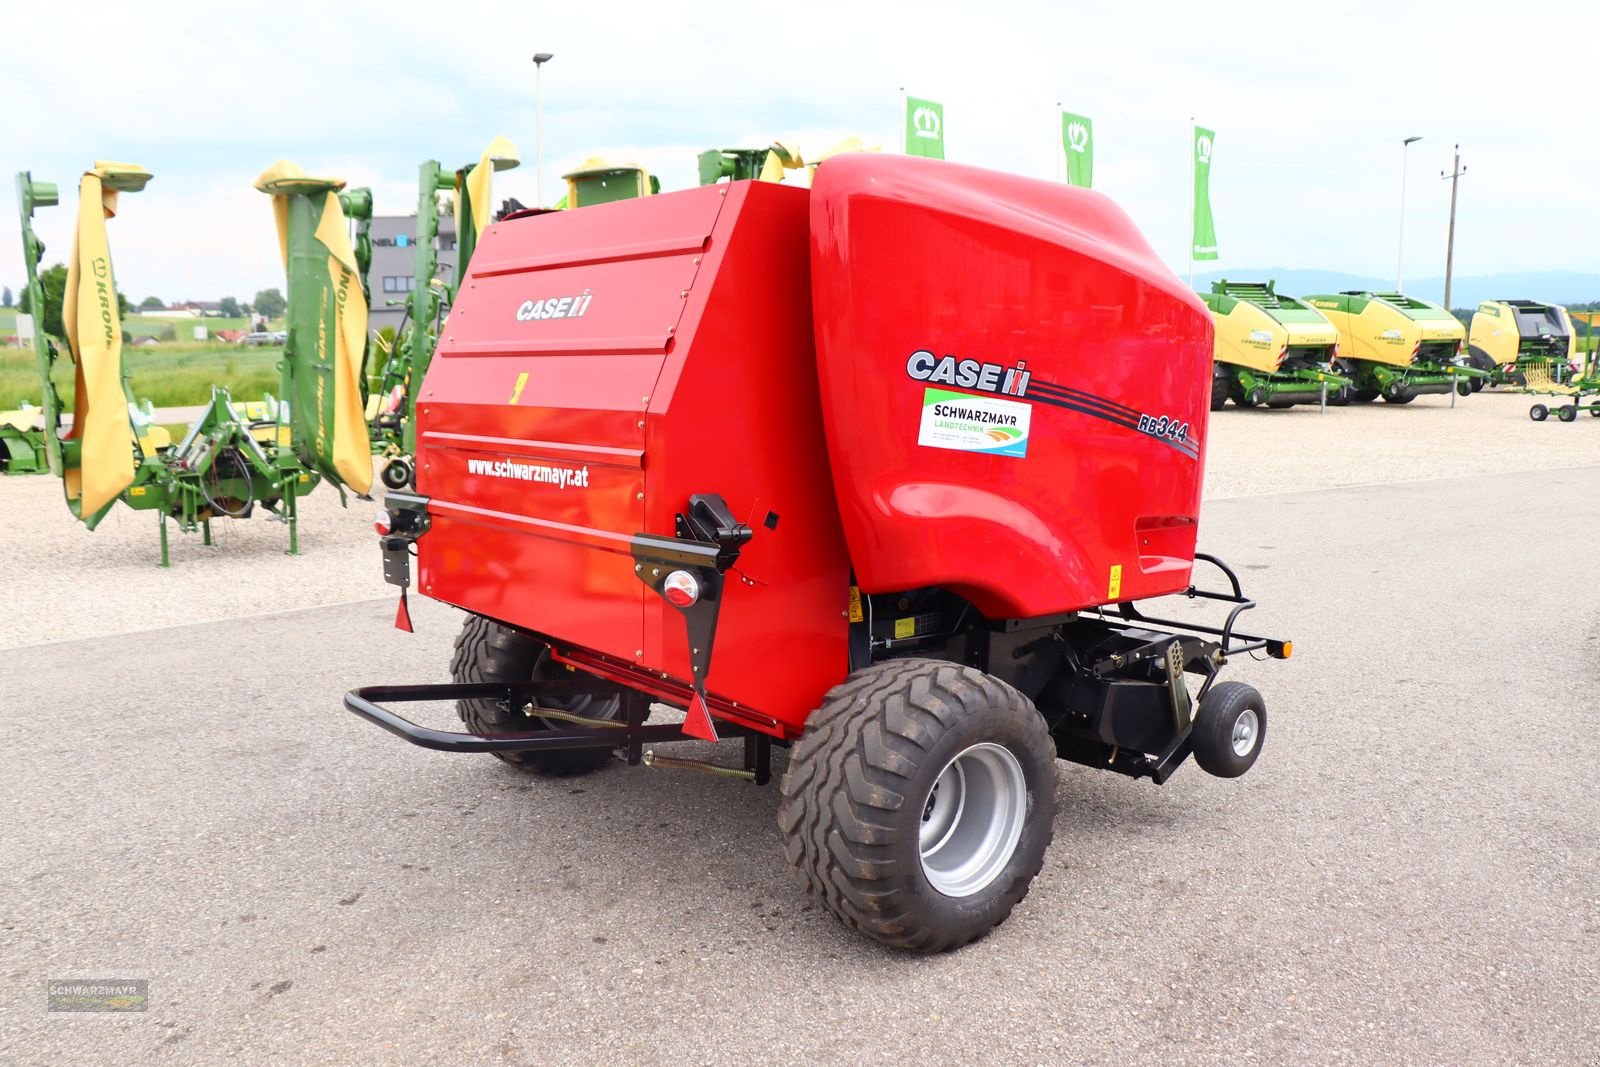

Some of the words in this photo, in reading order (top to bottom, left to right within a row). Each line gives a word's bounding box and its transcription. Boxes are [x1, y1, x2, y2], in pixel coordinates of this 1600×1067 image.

[516, 297, 571, 321] CASE
[906, 350, 1002, 392] CASE
[934, 404, 1017, 426] SCHWARZMAYR
[934, 419, 985, 433] LANDTECHNIK
[467, 458, 589, 489] www.schwarzmayr.at
